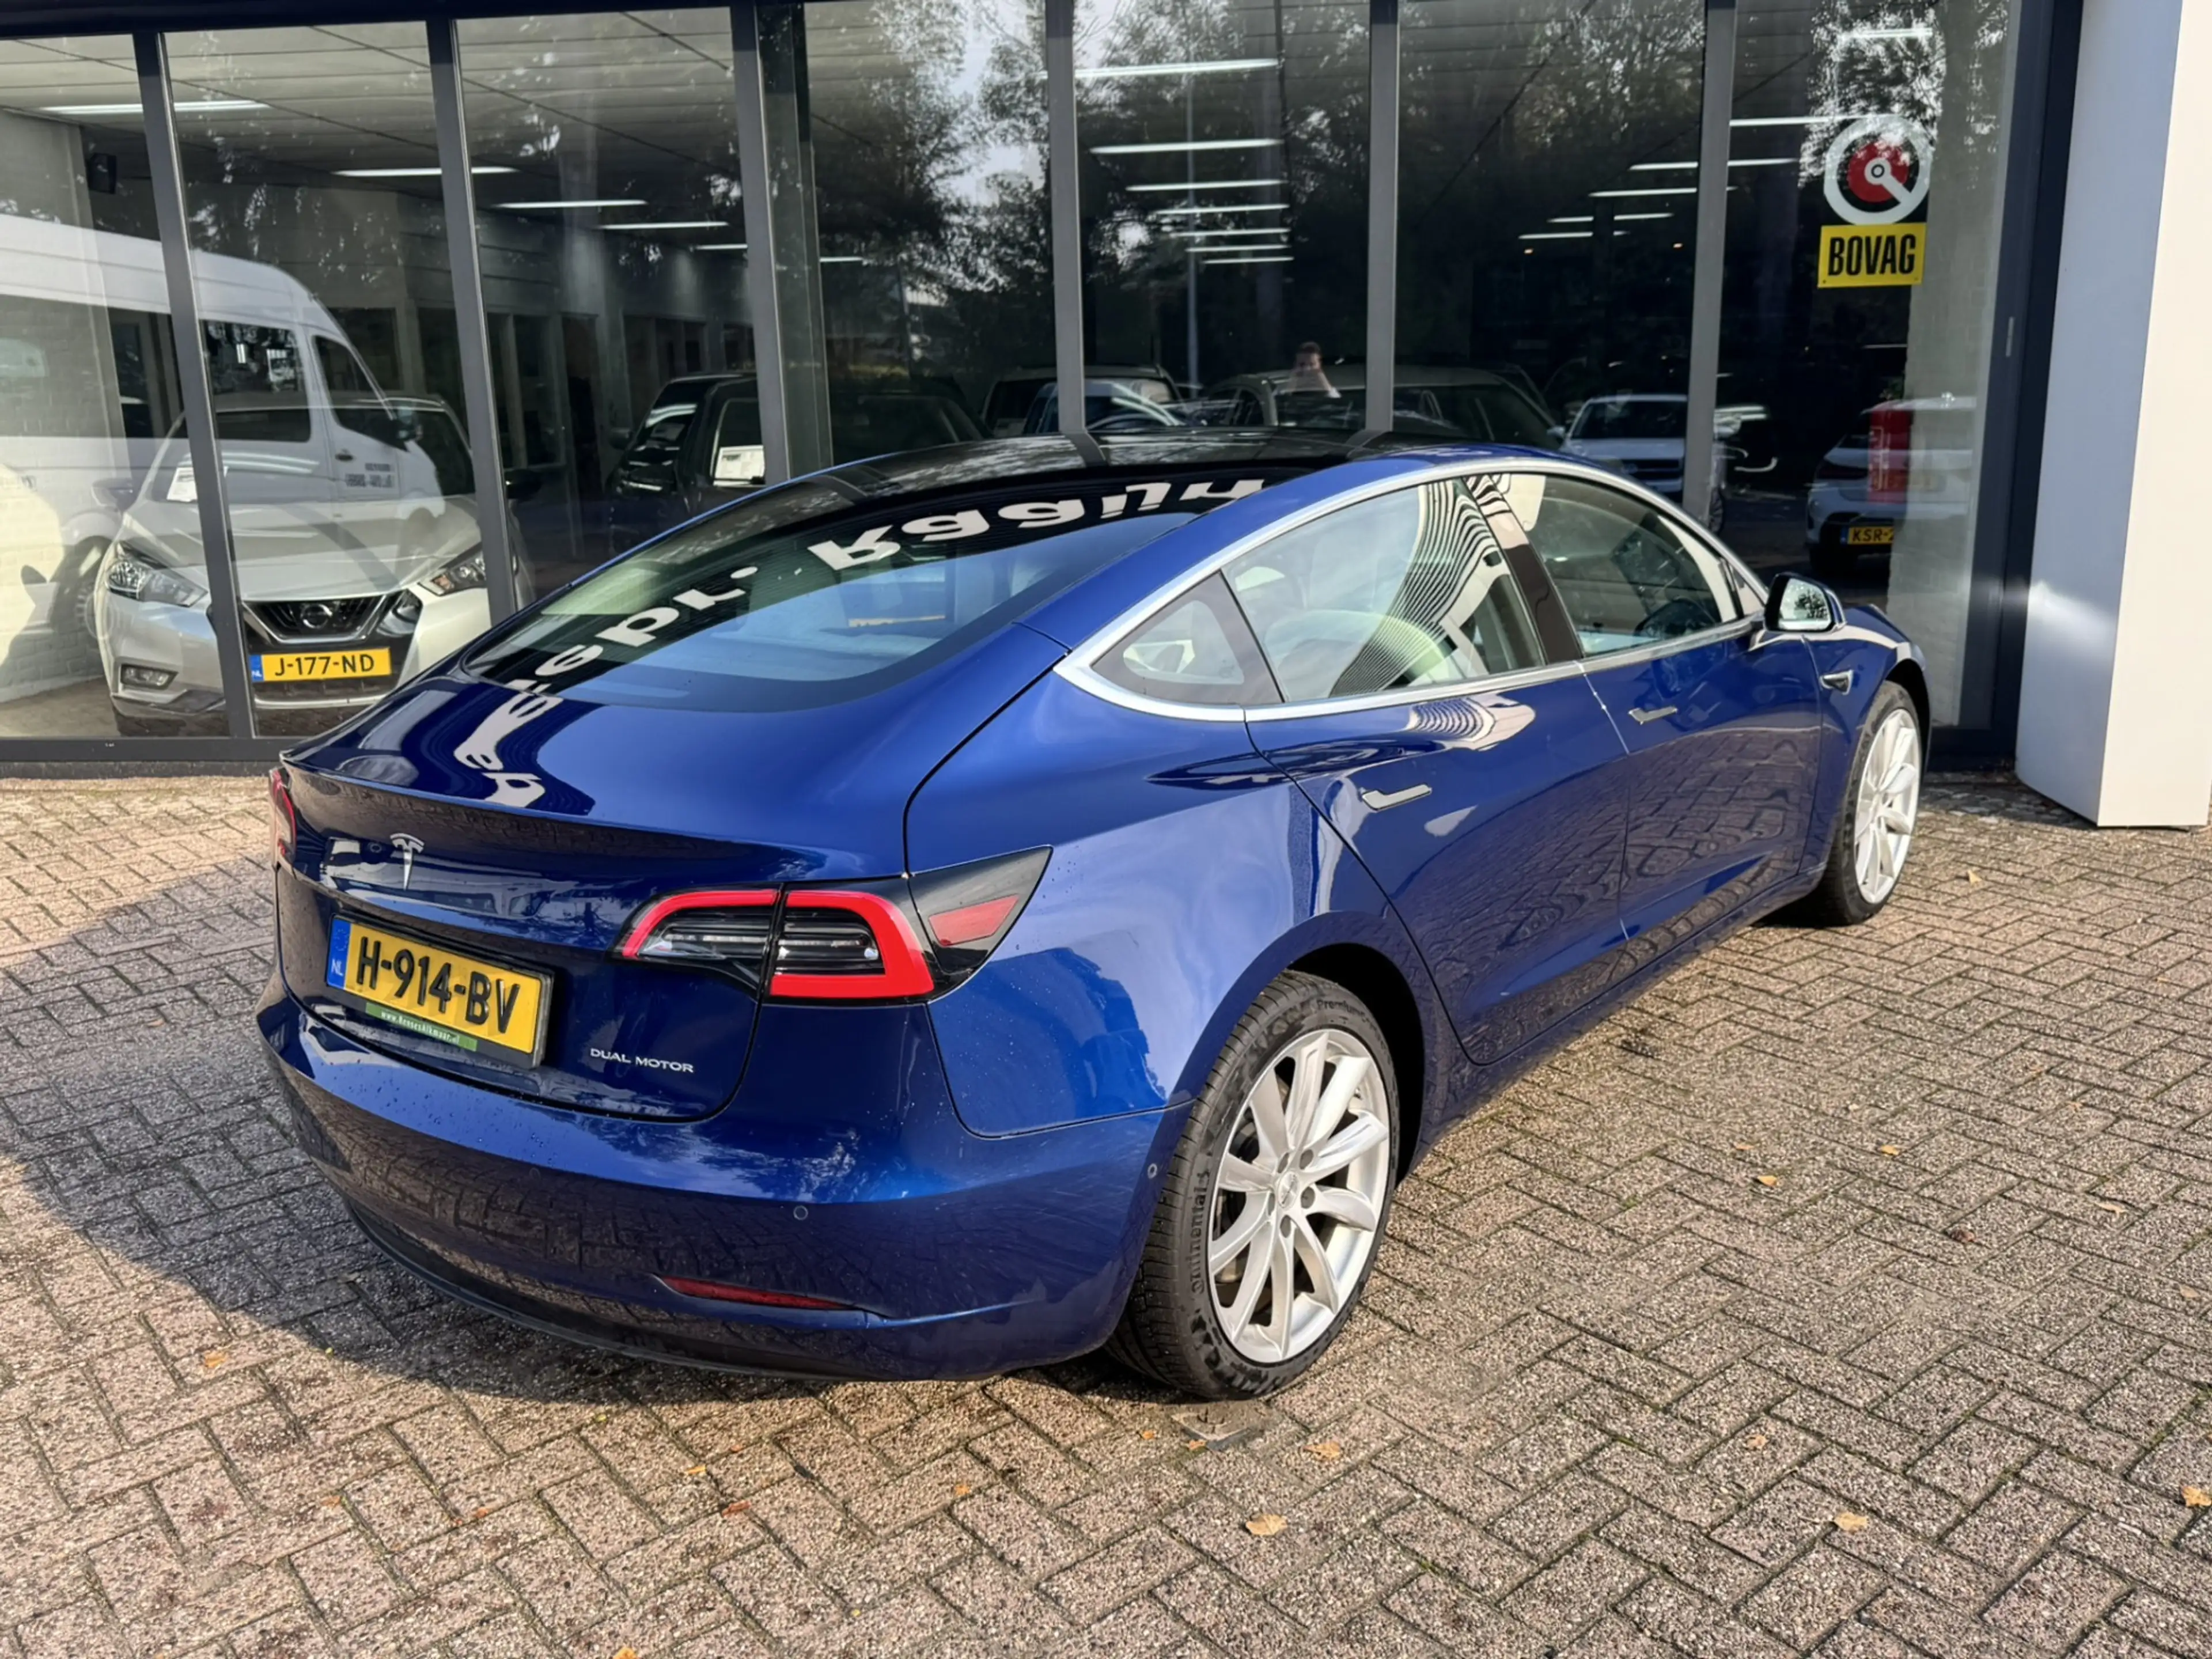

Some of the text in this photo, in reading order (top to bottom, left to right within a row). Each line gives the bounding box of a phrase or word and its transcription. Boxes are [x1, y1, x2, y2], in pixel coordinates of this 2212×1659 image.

[1827, 233, 1916, 276] BOVAG
[275, 654, 374, 676] J-177-ND
[331, 959, 344, 977] NL
[356, 936, 521, 1034] H-914-BV
[590, 1048, 694, 1074] DUAL MOTOR
